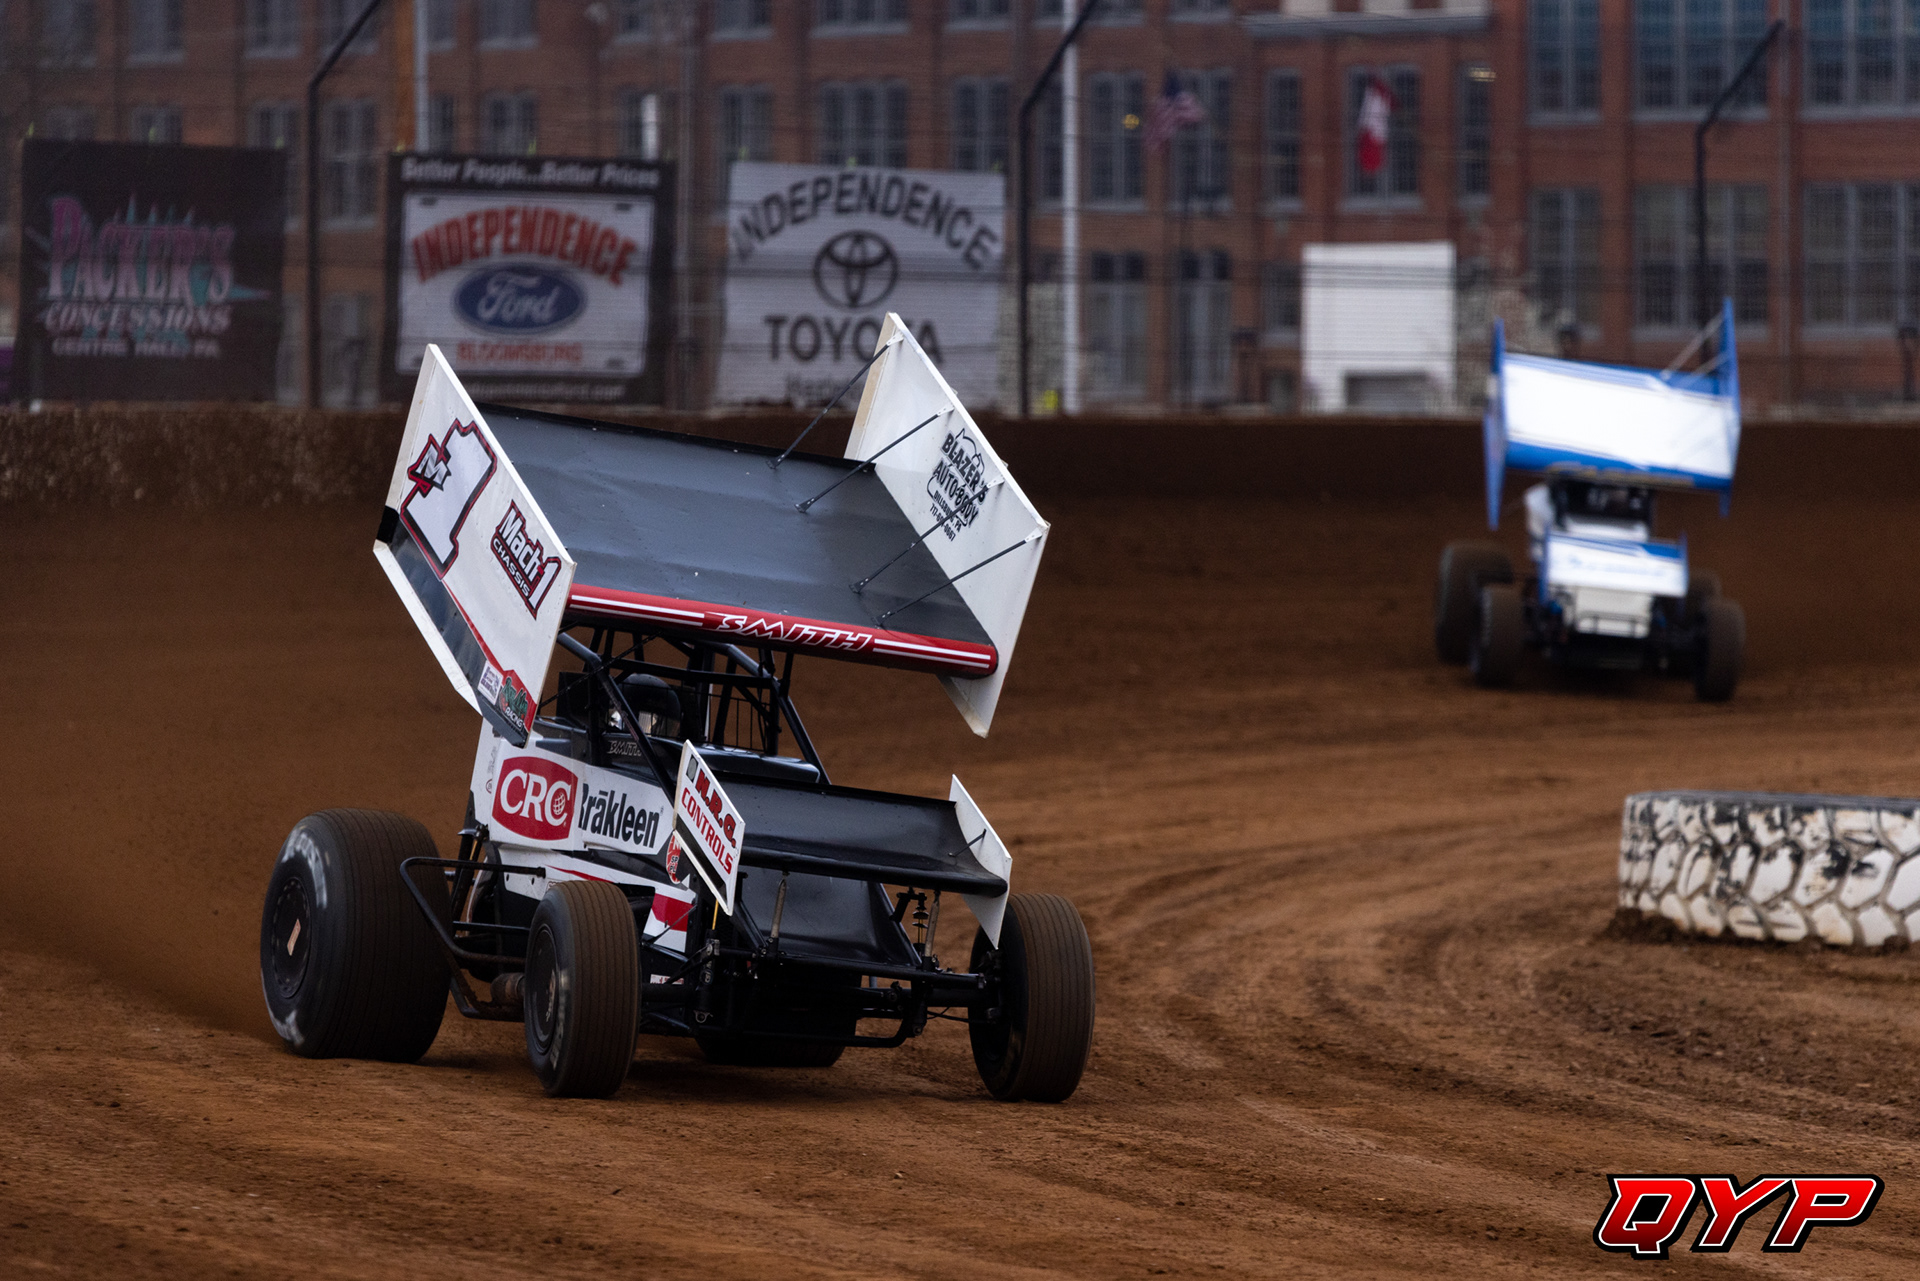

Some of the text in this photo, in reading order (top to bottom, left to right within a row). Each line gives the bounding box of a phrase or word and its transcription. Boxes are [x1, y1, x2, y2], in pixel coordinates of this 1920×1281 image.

[412, 205, 637, 286] INDEPENDENCE
[731, 172, 998, 271] INDEPENDENCE
[476, 270, 560, 322] Ford
[764, 314, 943, 365] TOYOA
[493, 538, 530, 597] CHASSIS
[497, 506, 541, 583] Mach
[706, 612, 873, 652] SMITH
[505, 706, 523, 728] RACING
[500, 768, 572, 827] CRC
[695, 768, 737, 849] N.R.G.
[681, 787, 734, 875] CONTROLS
